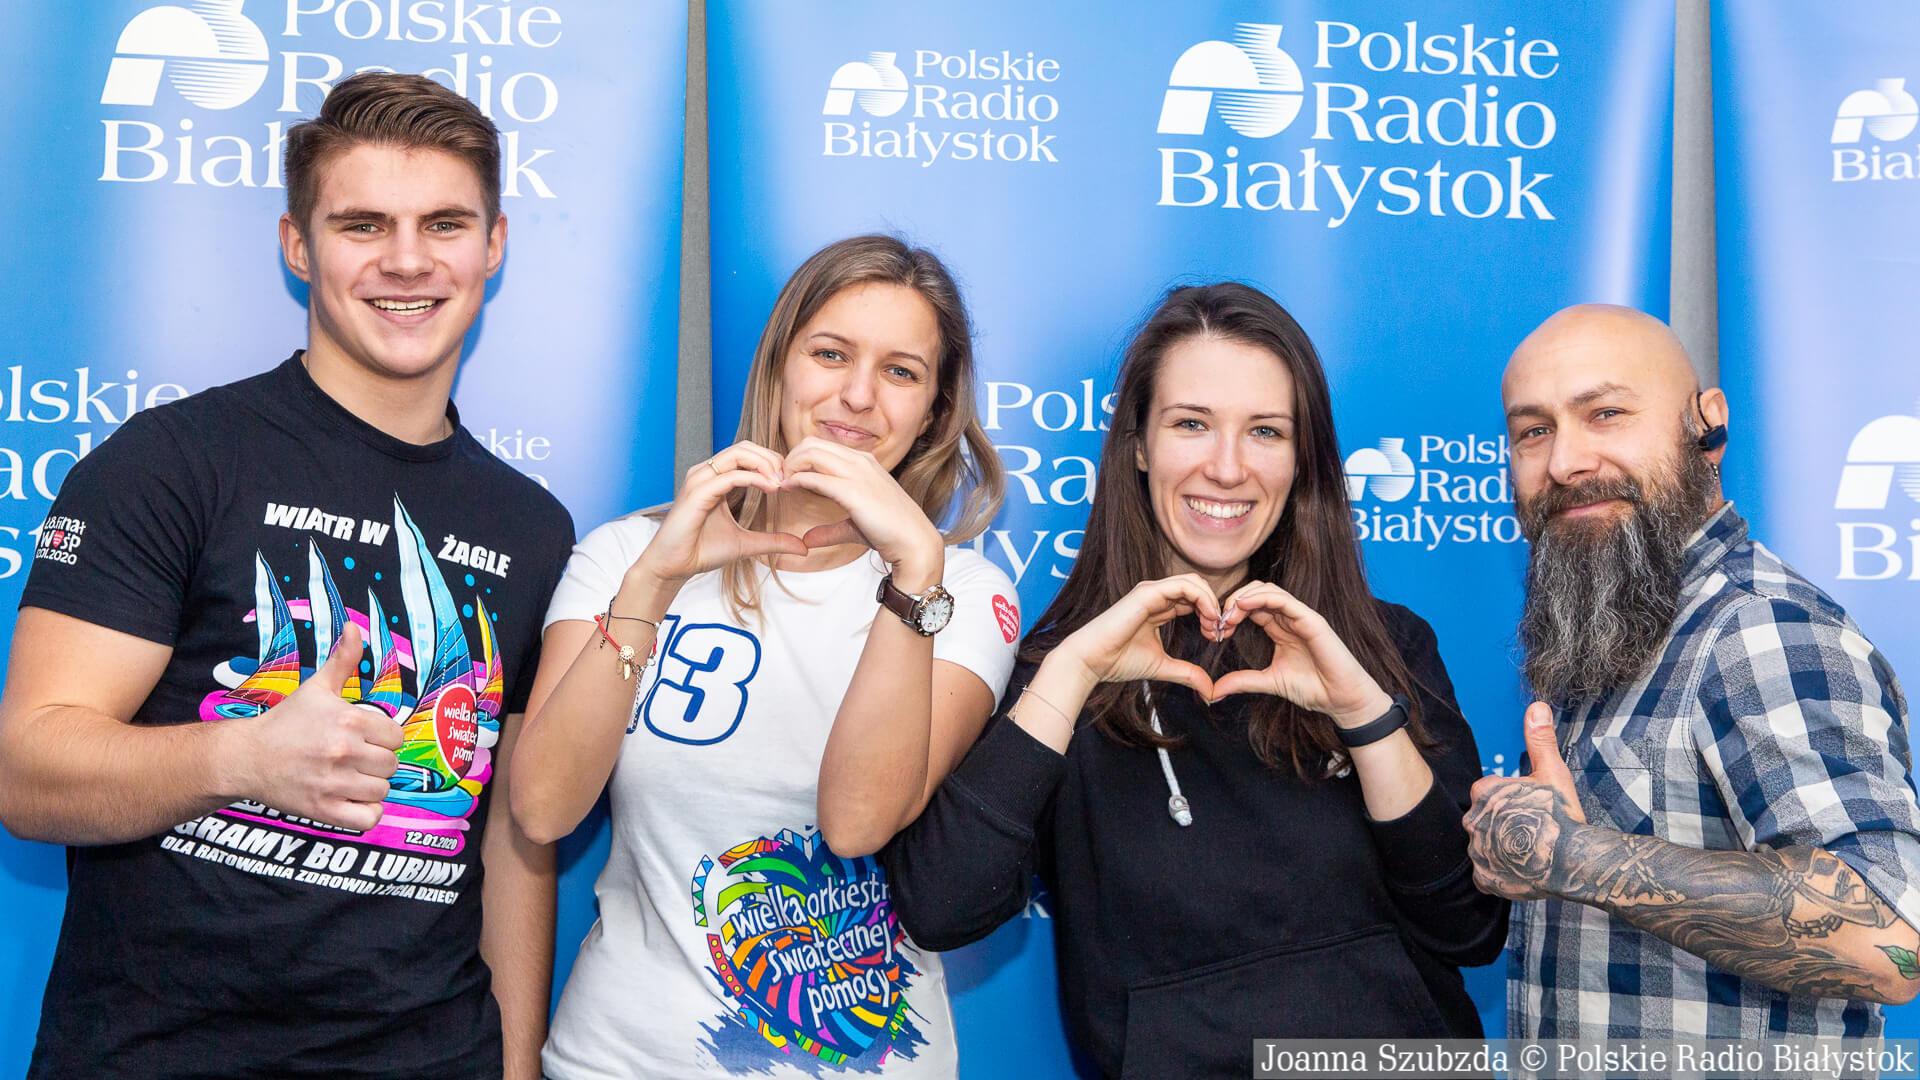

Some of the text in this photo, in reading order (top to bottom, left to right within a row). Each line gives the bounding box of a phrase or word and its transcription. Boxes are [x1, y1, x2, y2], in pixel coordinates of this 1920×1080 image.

[281, 0, 562, 48] Polskie
[1313, 20, 1560, 79] Polskie
[276, 51, 559, 123] Rdio
[913, 49, 1061, 82] Polskie
[912, 83, 1060, 122] Radio
[1311, 81, 1557, 150] Radio
[98, 118, 558, 199] Białk
[822, 121, 1060, 168] Białystok
[1156, 145, 1557, 229] Białystok
[1418, 467, 1515, 504] Rad
[264, 502, 390, 546] WIATR W
[1350, 505, 1528, 551] Białysto
[437, 533, 512, 579] ŻAGLE
[174, 816, 307, 865] GRAMY,
[302, 841, 359, 873] BO
[359, 850, 467, 887] LUBIMY
[405, 831, 458, 851] 12.01.2020
[160, 835, 196, 855] DLA
[194, 843, 295, 880] RATOWANIA
[295, 868, 376, 895] ZDROWIA
[414, 886, 460, 905] DZIECI
[730, 871, 891, 939] wielka orkiestr
[806, 967, 891, 1029] pomocy
